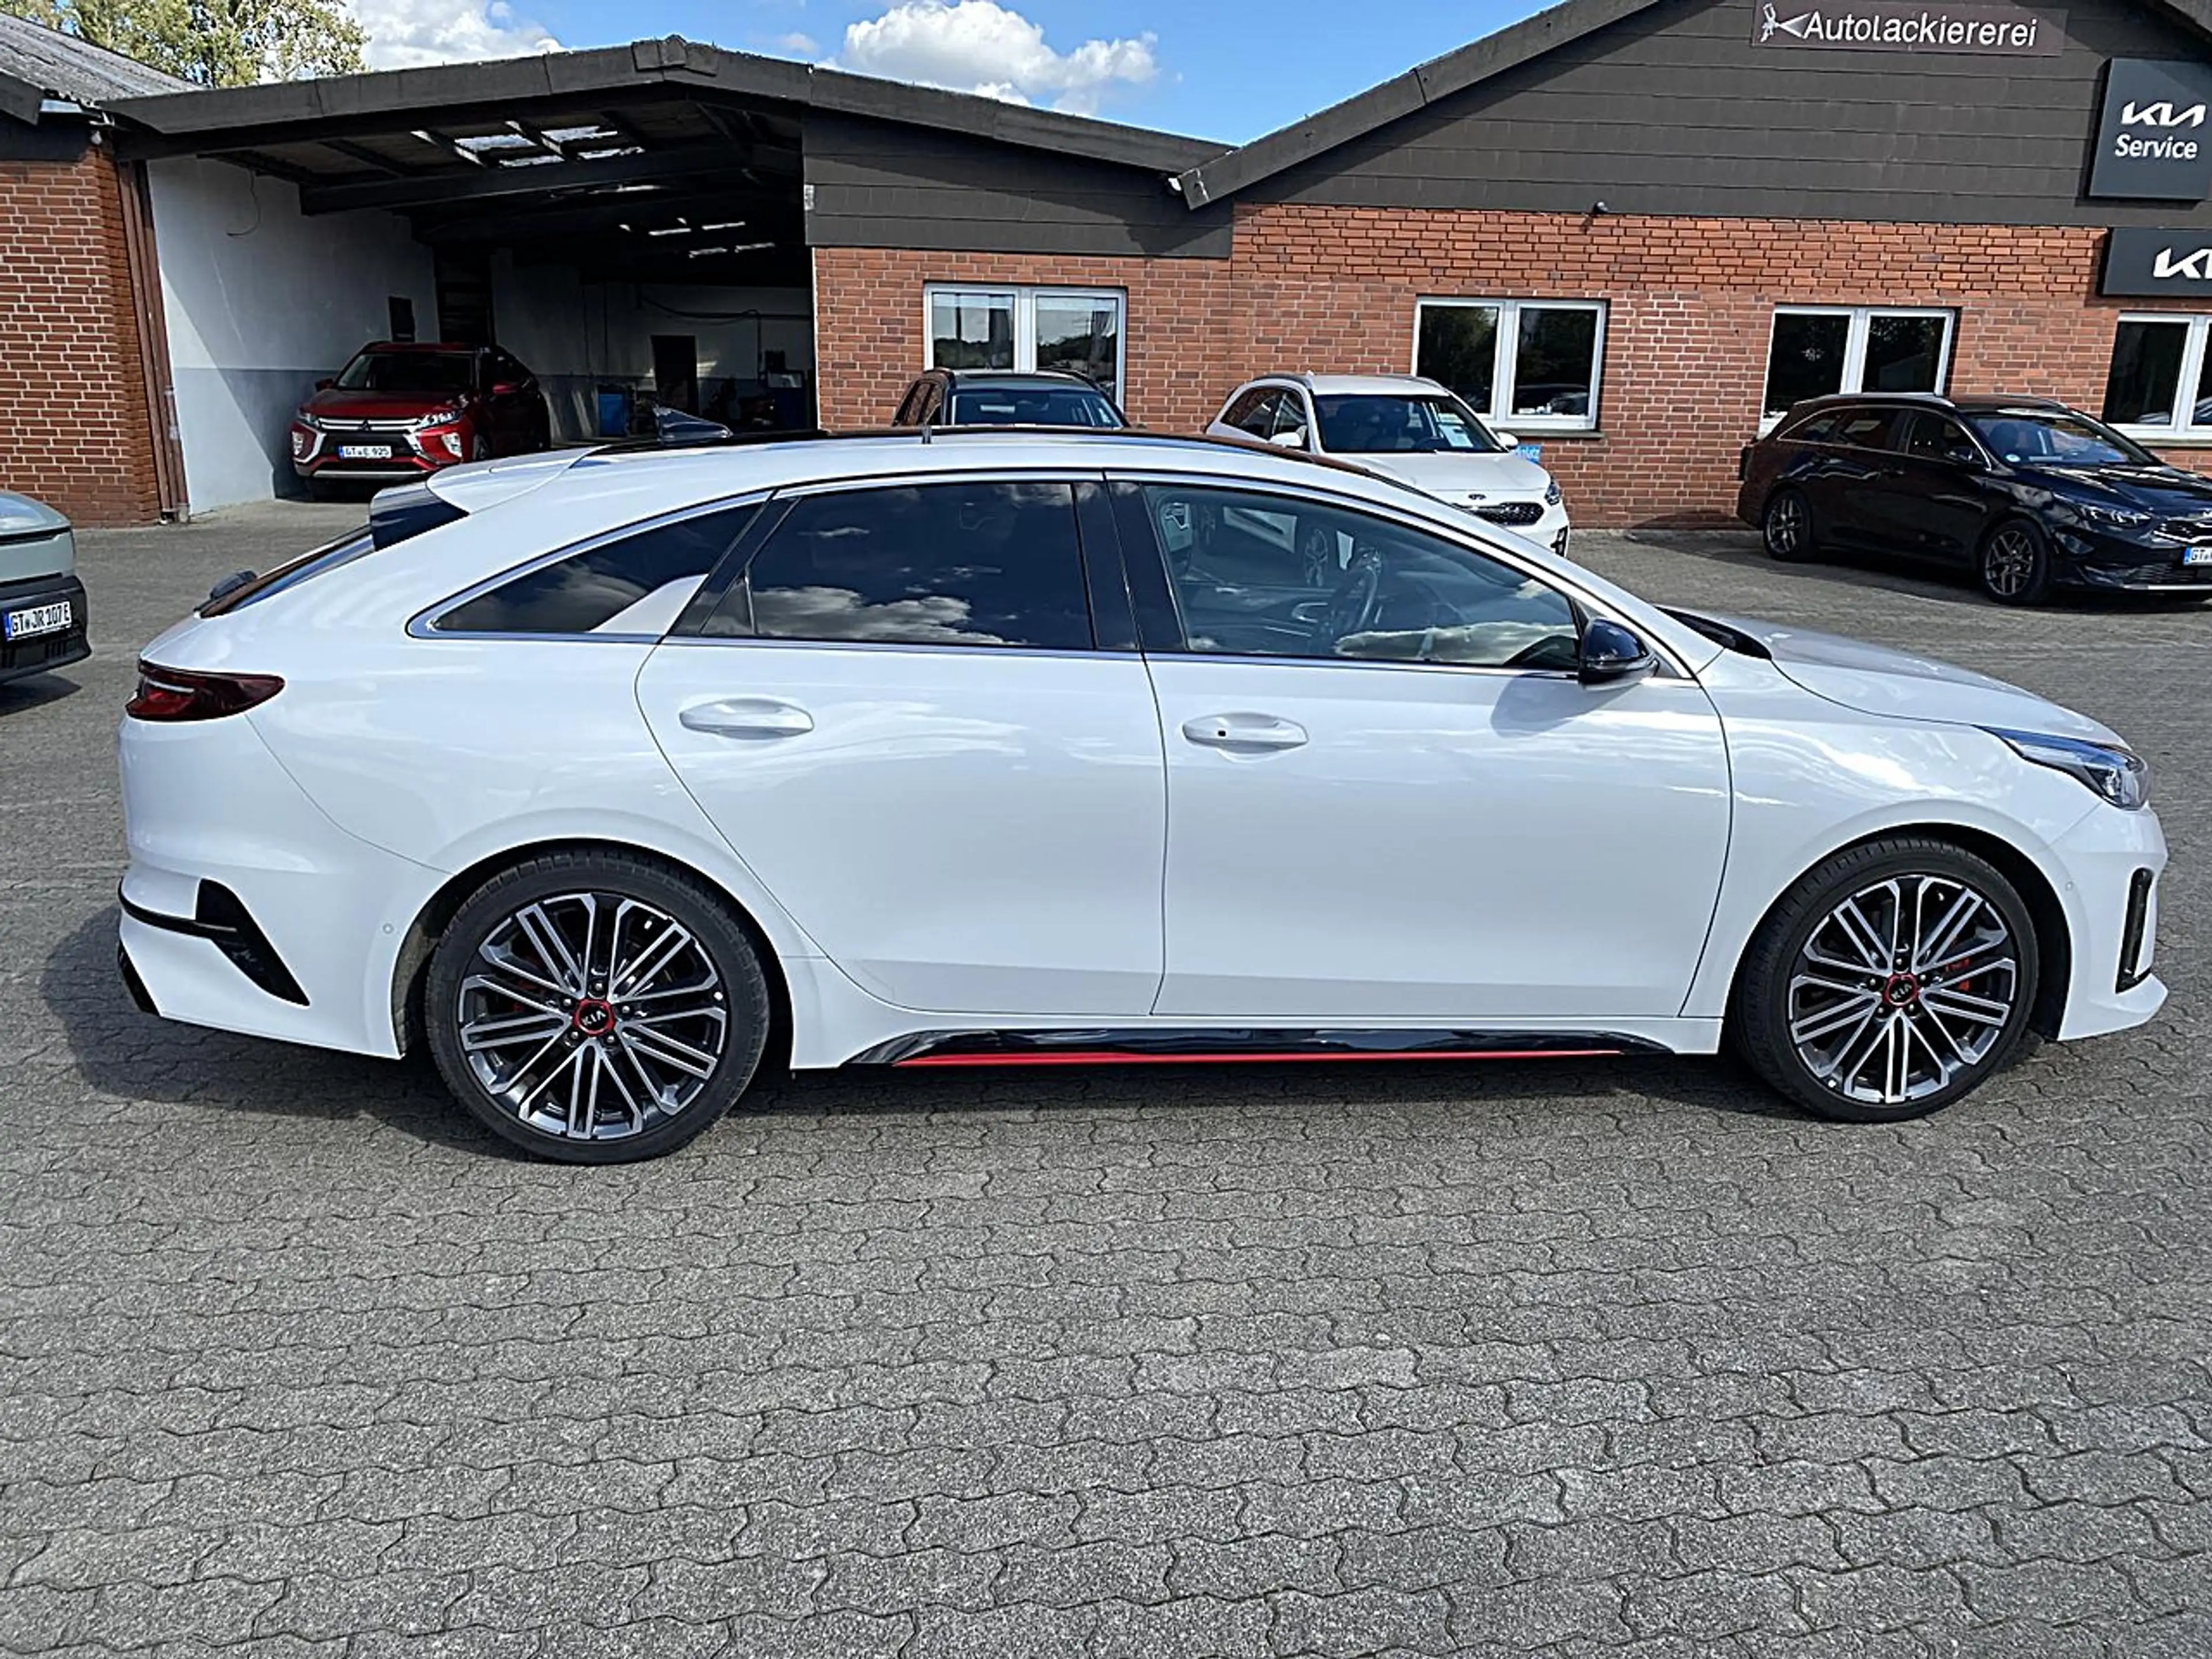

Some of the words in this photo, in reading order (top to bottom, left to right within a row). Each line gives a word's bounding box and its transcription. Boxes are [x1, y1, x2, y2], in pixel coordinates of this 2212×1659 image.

[1803, 10, 2037, 47] Autolackiererei
[2114, 133, 2198, 161] Service
[581, 1010, 607, 1027] KIA
